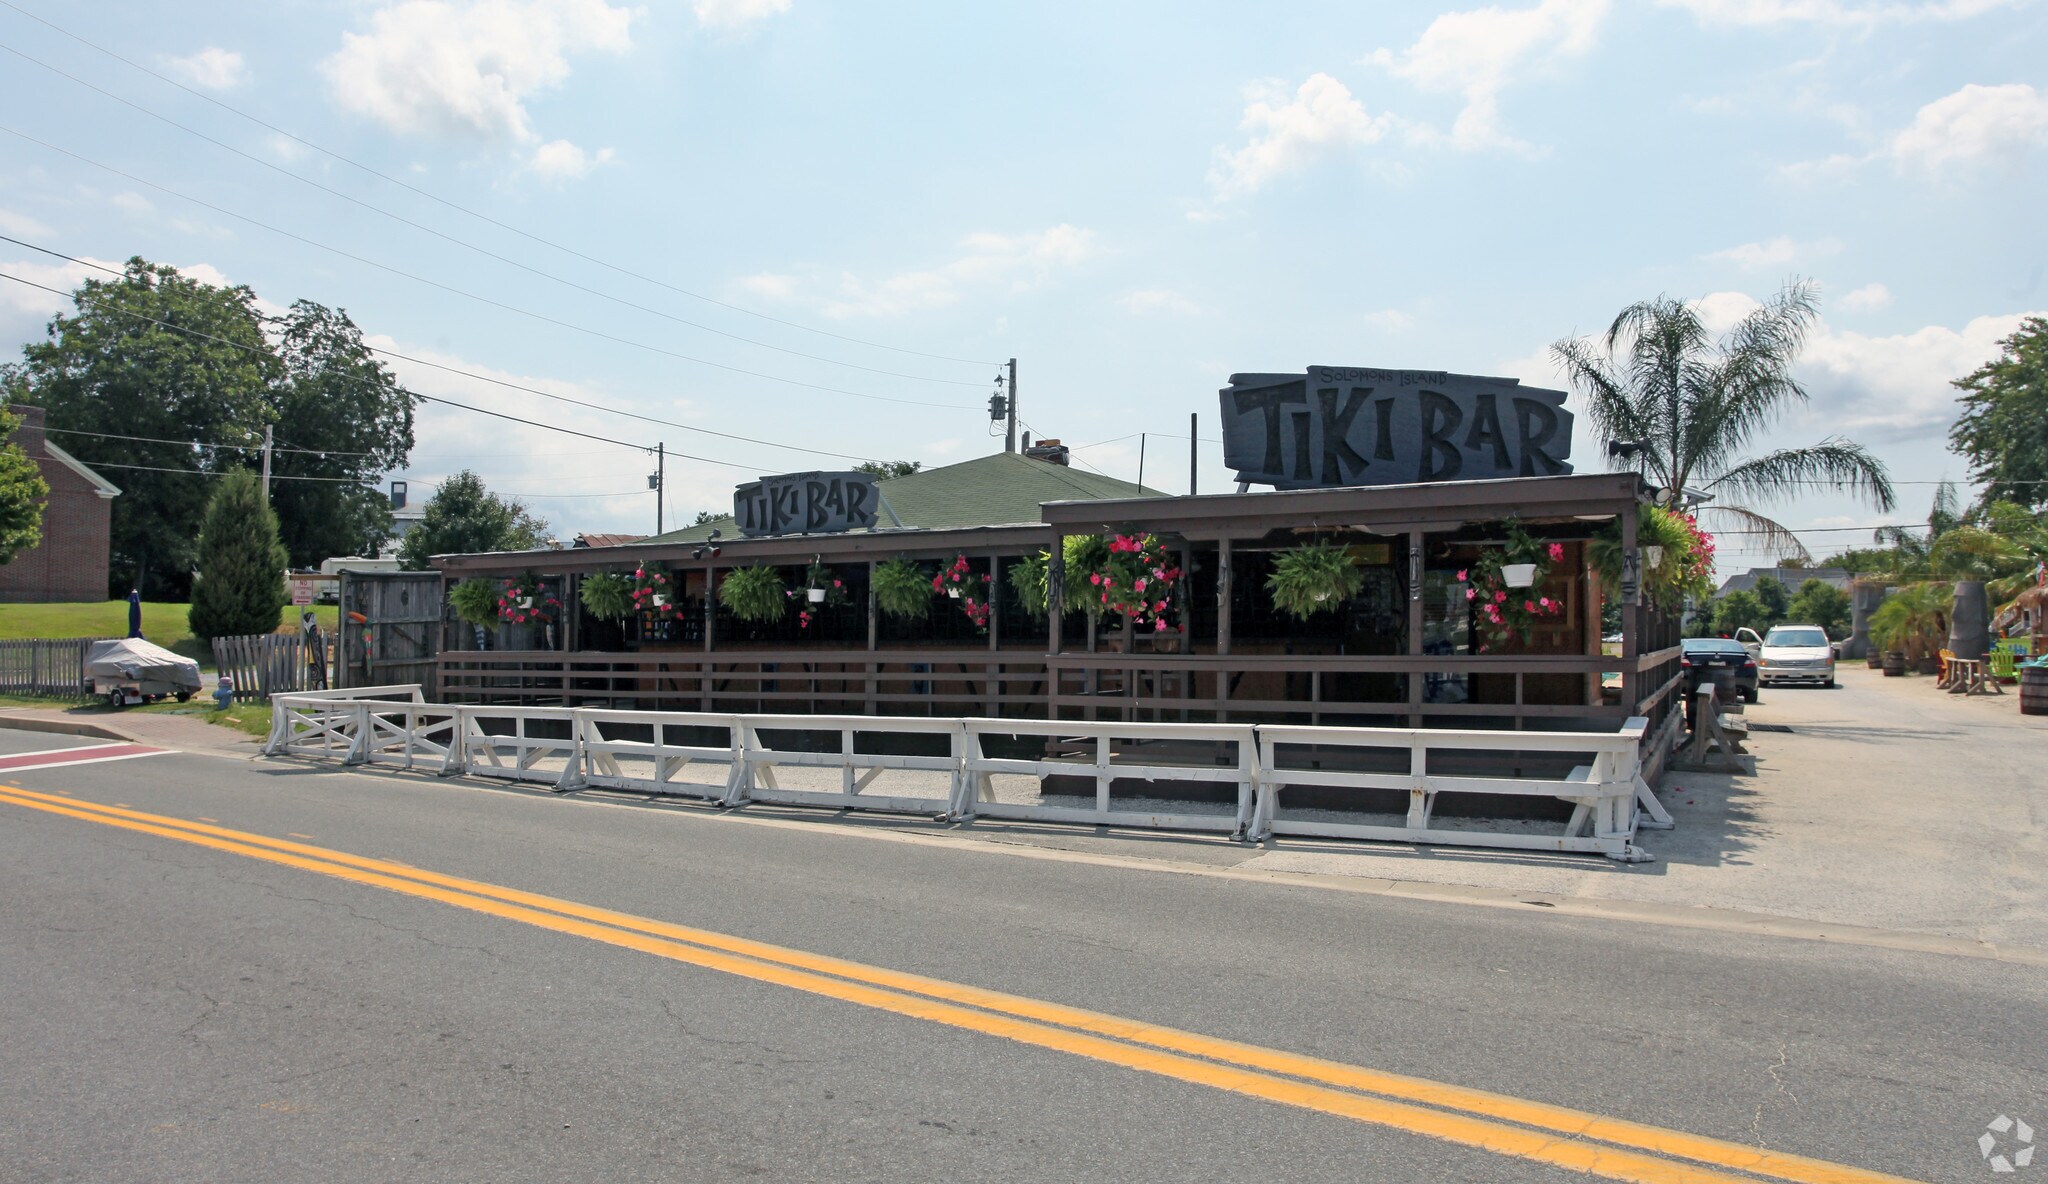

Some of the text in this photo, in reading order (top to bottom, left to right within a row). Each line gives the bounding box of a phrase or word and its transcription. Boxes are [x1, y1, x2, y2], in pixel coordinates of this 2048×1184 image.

[1320, 367, 1447, 386] SOLOMONS ISLAND
[1232, 379, 1566, 485] TIKI BAR
[737, 478, 869, 532] TIKI BAR
